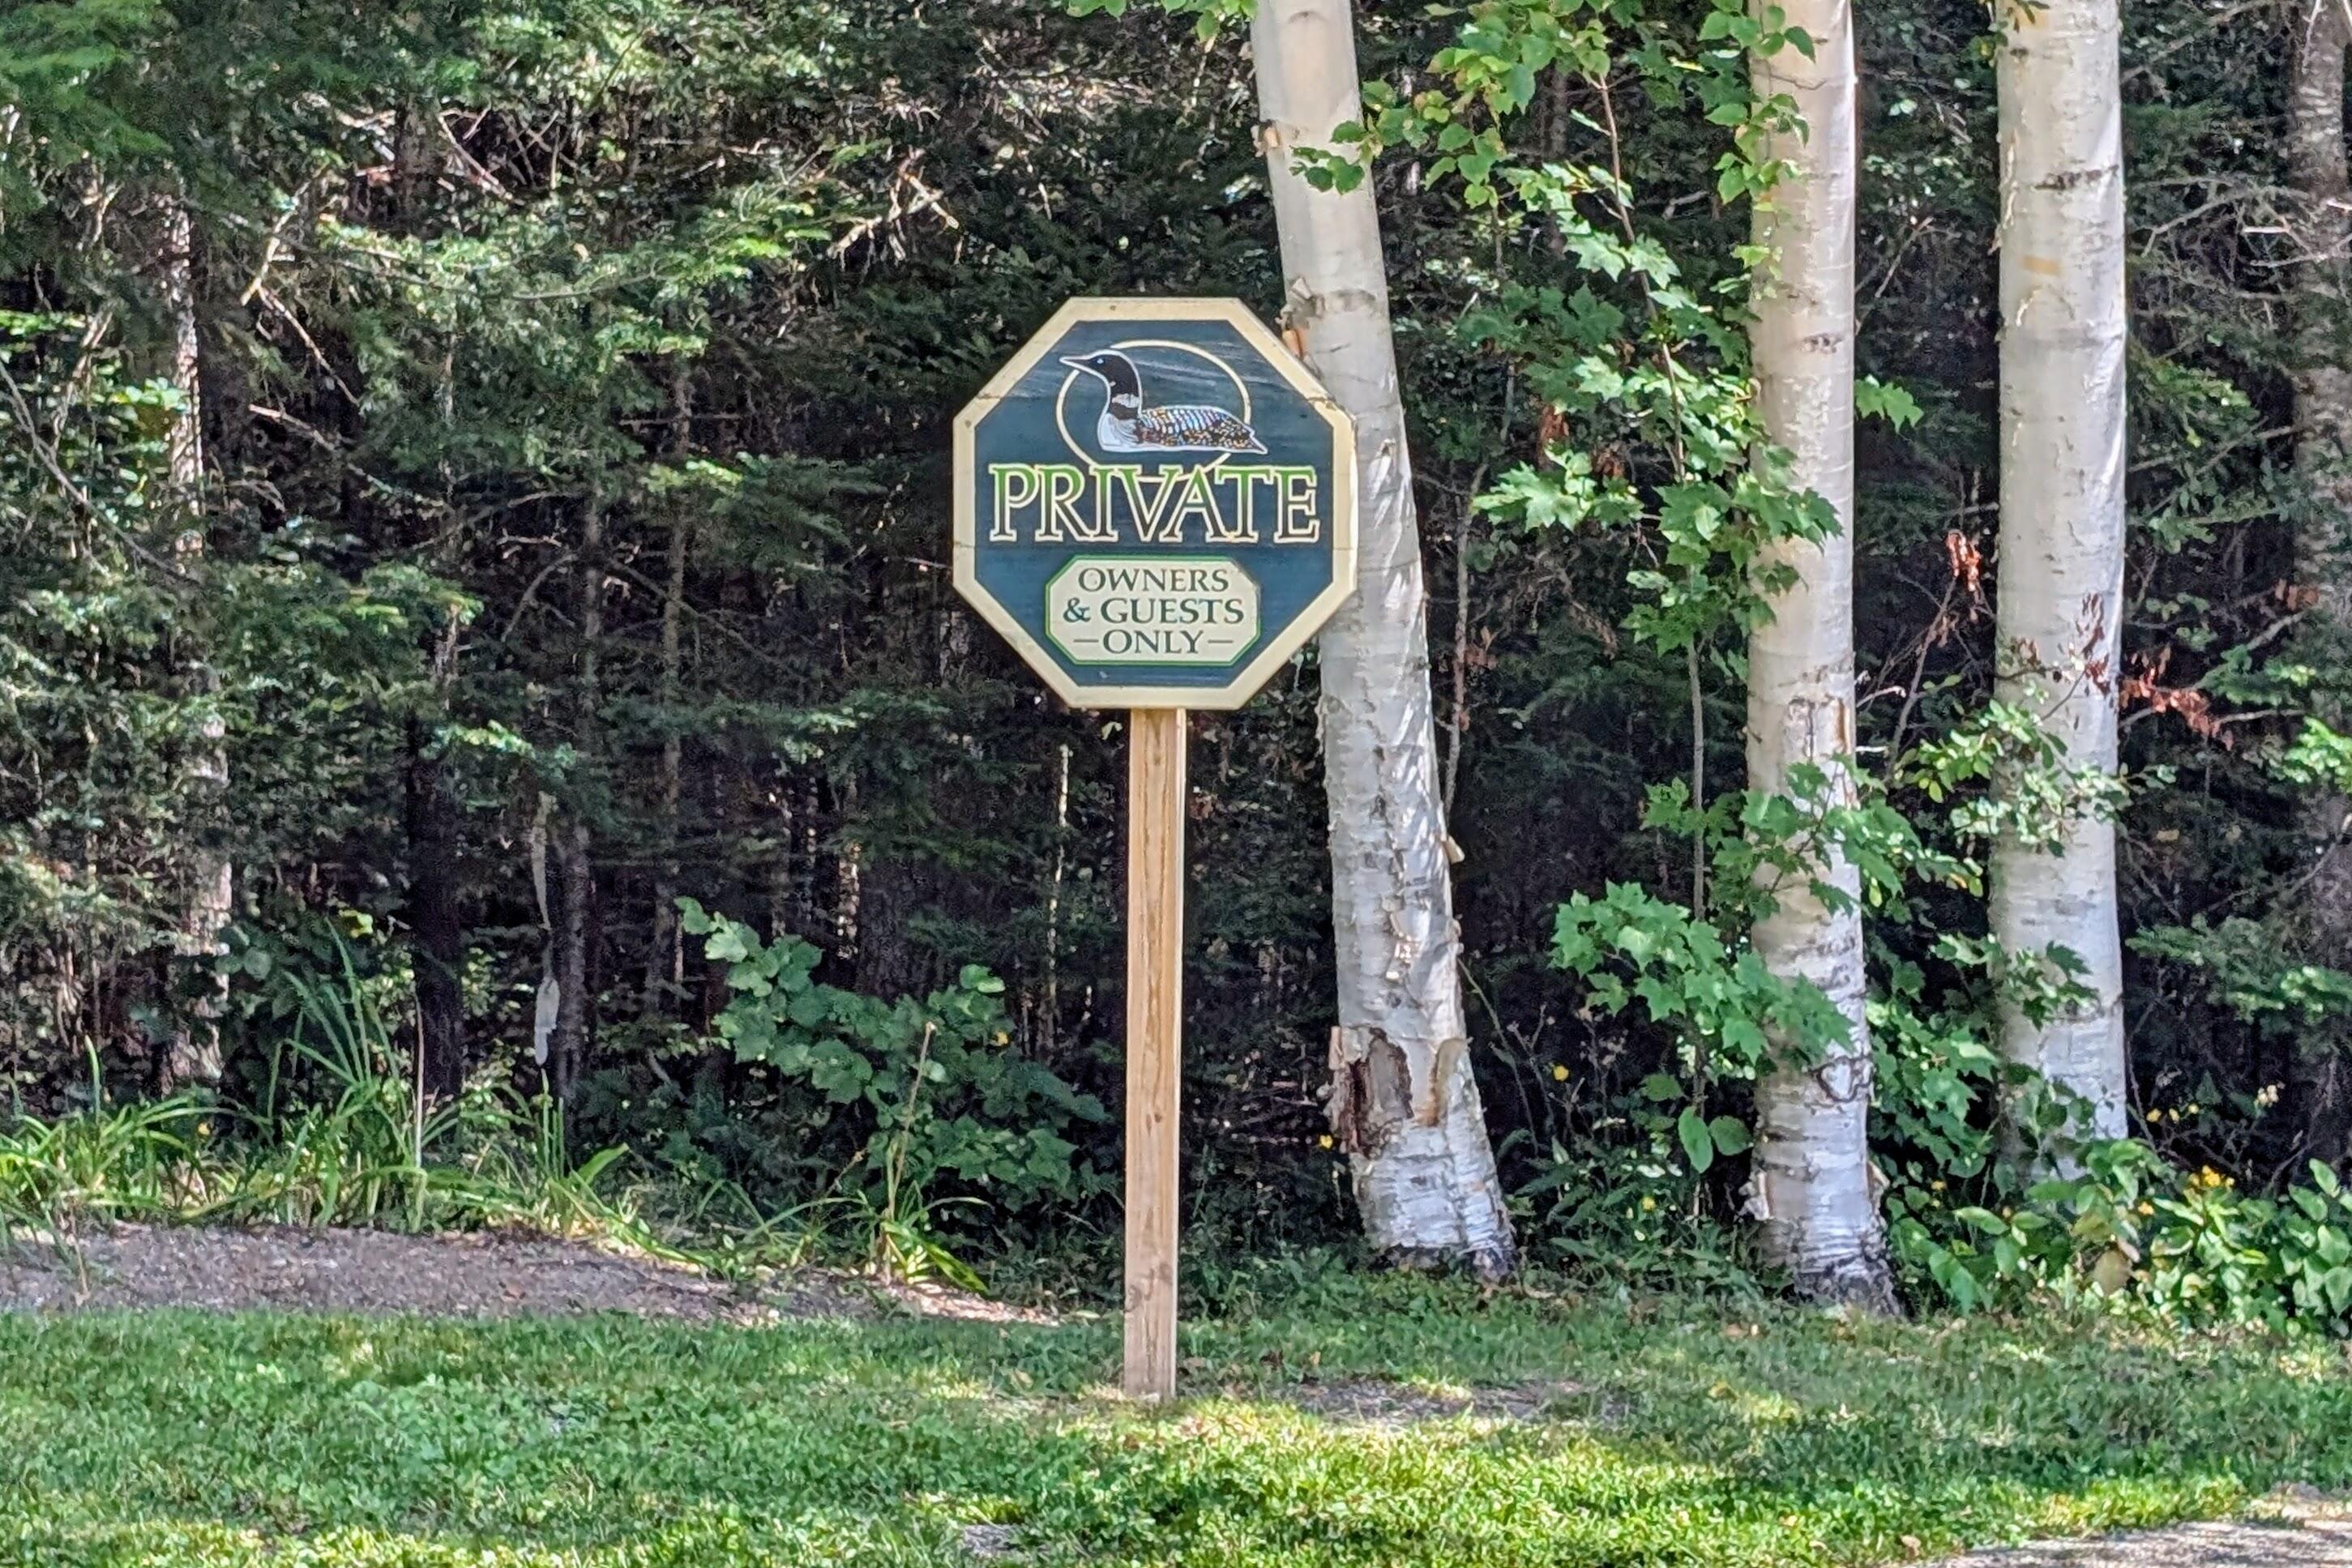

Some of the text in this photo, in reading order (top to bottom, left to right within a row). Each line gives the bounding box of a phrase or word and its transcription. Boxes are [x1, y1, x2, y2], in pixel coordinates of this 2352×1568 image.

[988, 464, 1321, 544] PRIVATE
[1078, 568, 1229, 592] OWNERS
[1063, 597, 1243, 624] & GUESTS
[1102, 630, 1204, 654] ONLY
